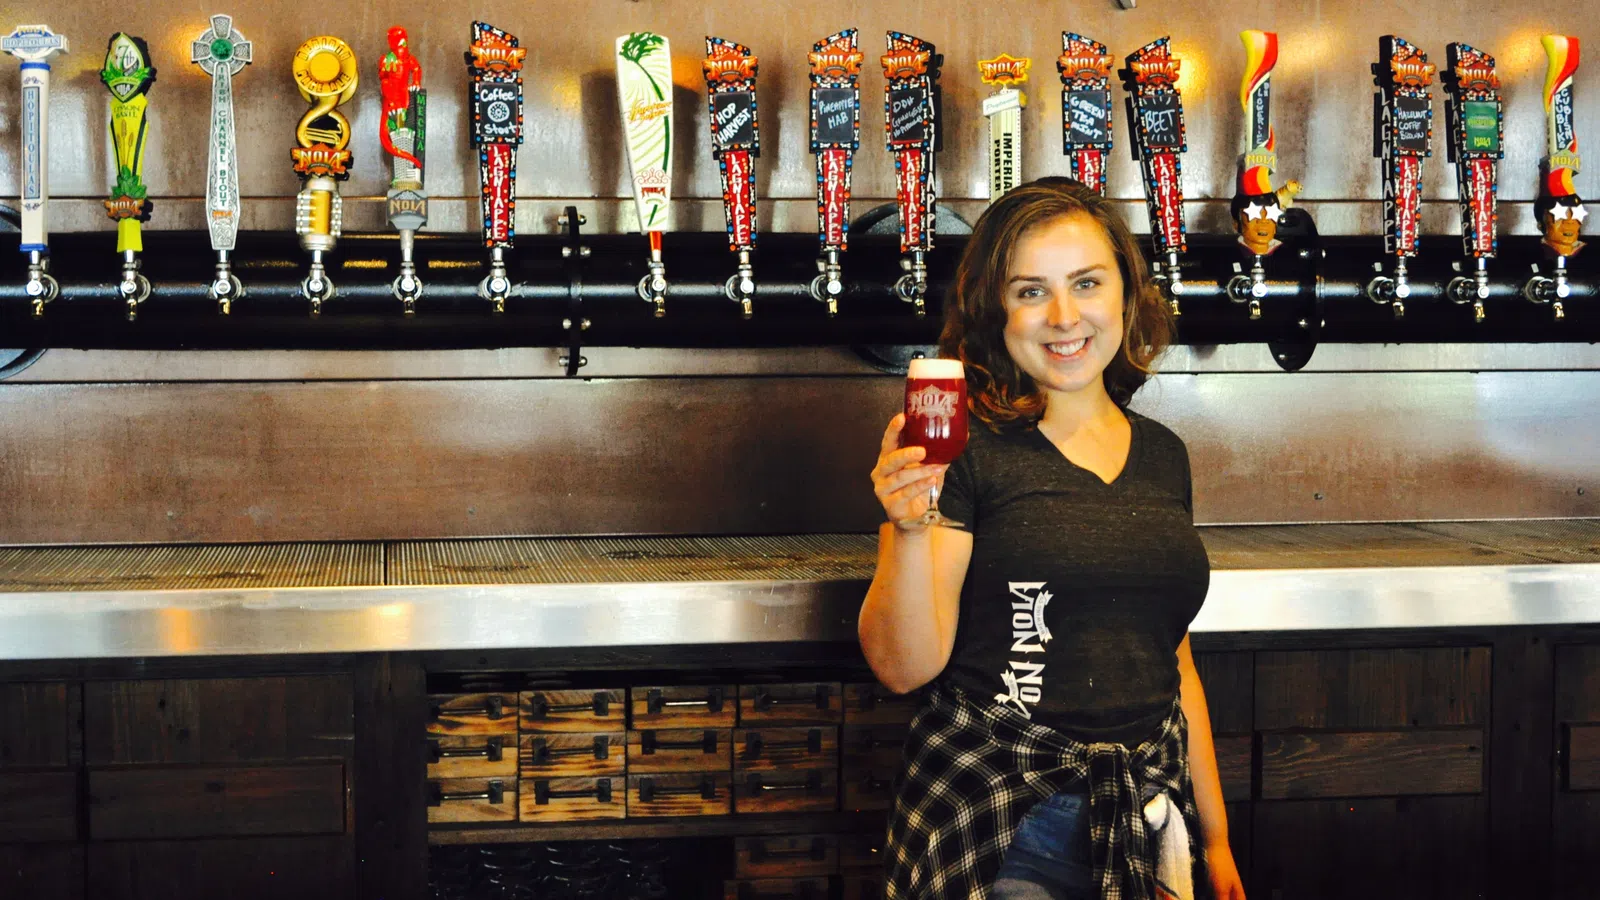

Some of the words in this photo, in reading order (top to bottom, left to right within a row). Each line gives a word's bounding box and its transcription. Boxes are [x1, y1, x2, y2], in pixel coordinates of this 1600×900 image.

[477, 46, 518, 64] NOLA
[817, 54, 855, 71] NOLA
[888, 54, 923, 70] NOLA
[712, 59, 749, 75] NOLA
[987, 61, 1020, 78] NOLA
[1067, 57, 1106, 74] NOLA
[1138, 62, 1174, 79] NOLA
[1397, 63, 1429, 80] NOLA
[1463, 68, 1497, 85] NOLA
[480, 87, 516, 102] Coffee
[416, 94, 427, 151] MECHA
[716, 102, 737, 125] HOP
[827, 112, 849, 130] HAB
[1145, 108, 1176, 133] BEET
[716, 108, 751, 144] HARVEST
[26, 90, 35, 195] HOPITOULAS
[217, 110, 227, 163] CHANNEL
[300, 151, 342, 170] NOLA
[1246, 154, 1277, 169] NOLA
[492, 145, 505, 239] LAGNIAPPE
[731, 153, 749, 244] LAGNIAPPE
[827, 150, 838, 243] LAGNIAPPE
[907, 152, 918, 243] LAGNIAPPE
[1159, 156, 1180, 246] LAGNIAPPE
[110, 200, 139, 213] NOLA
[390, 198, 427, 214] NOLA
[1401, 158, 1412, 250] LAGNIAPPE
[1476, 161, 1488, 250] LAGNIAPPE
[911, 392, 953, 413] NOLA
[1008, 581, 1048, 654] NOLA
